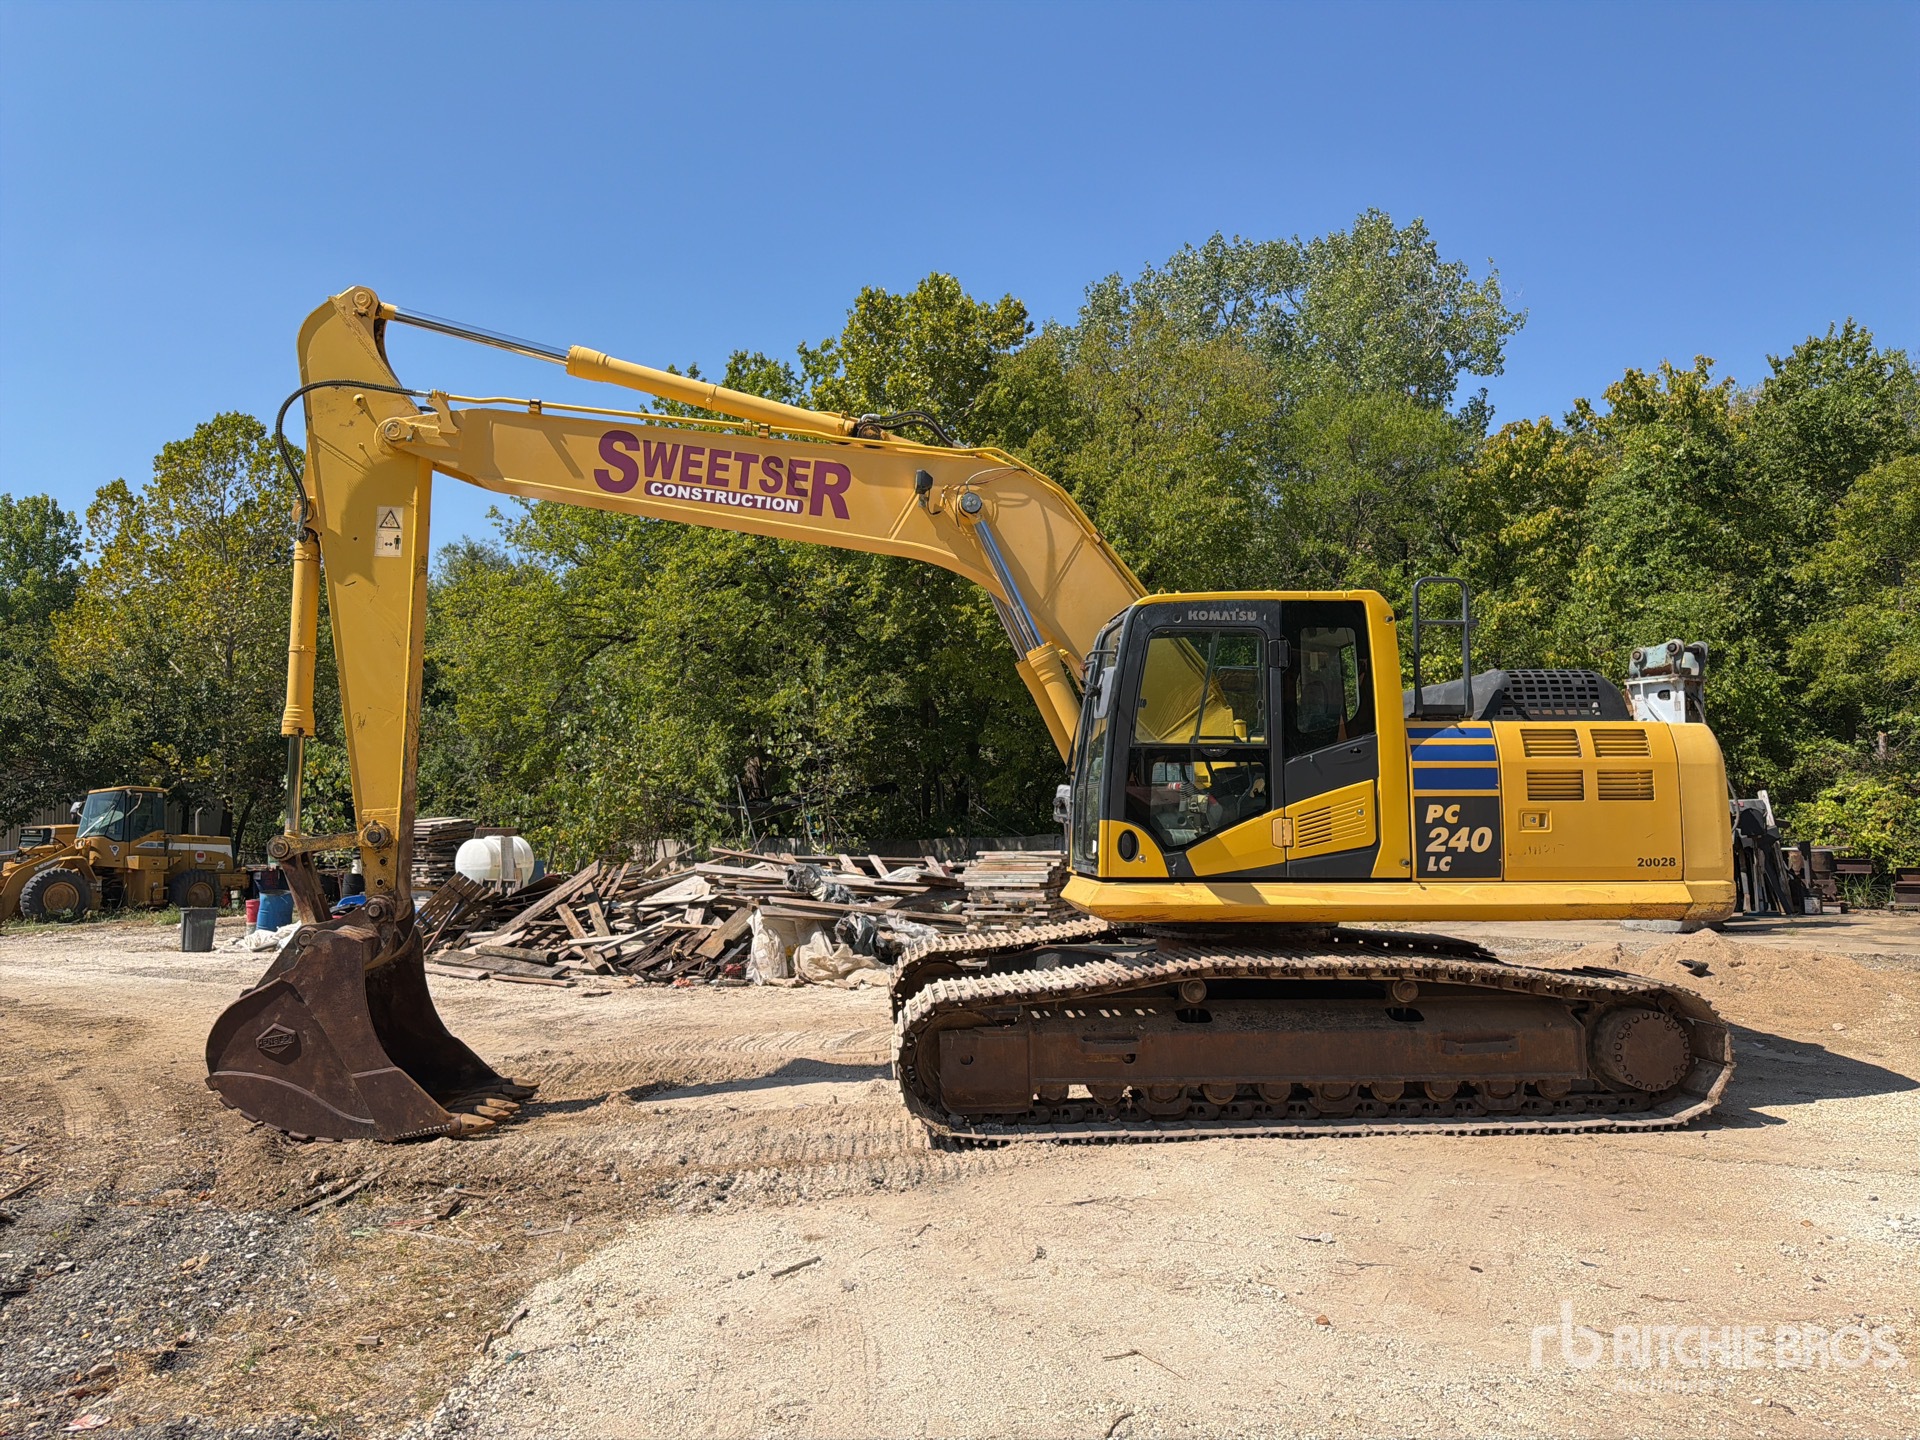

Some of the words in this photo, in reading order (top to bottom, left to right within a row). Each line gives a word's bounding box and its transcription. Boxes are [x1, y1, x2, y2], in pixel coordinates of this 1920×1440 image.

[594, 429, 852, 520] SWEETSER
[649, 481, 800, 514] CONSTRUCTION
[1187, 608, 1257, 621] KOMATSU
[1425, 804, 1461, 824] PC
[1425, 826, 1493, 853] 240
[1426, 856, 1452, 872] LC
[1637, 857, 1677, 868] 20028
